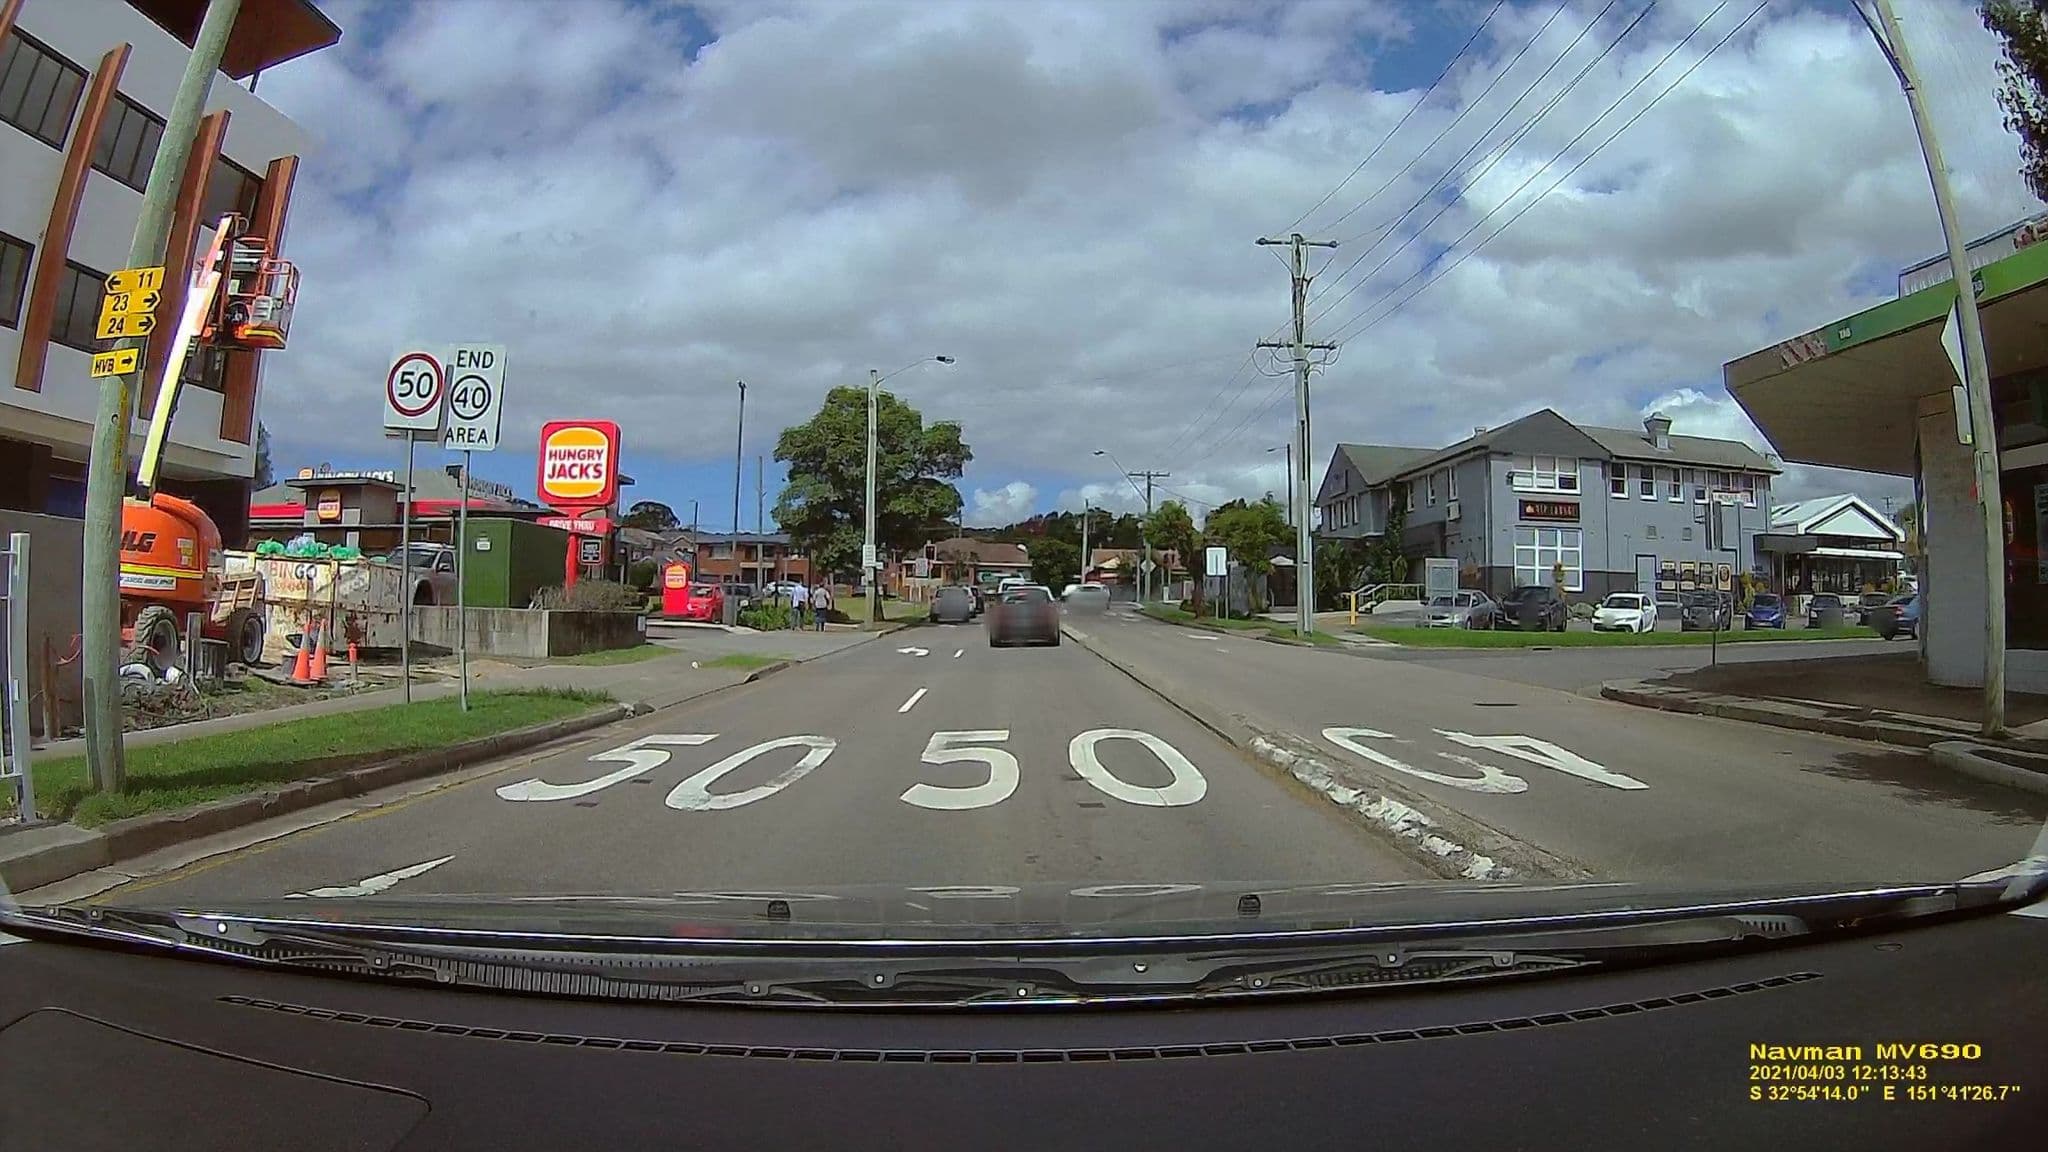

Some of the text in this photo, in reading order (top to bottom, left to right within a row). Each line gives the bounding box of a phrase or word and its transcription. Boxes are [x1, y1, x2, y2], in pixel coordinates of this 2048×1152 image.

[138, 271, 154, 289] 11
[111, 294, 129, 312] 23
[107, 317, 125, 335] 24
[456, 350, 494, 369] END
[398, 371, 434, 399] 50
[454, 386, 487, 409] 40
[444, 427, 489, 444] AREA
[548, 449, 604, 461] HUNGRY
[547, 463, 603, 480] JACK'S
[269, 560, 317, 580] BINGO
[496, 733, 838, 812] 50
[900, 727, 1208, 811] 50
